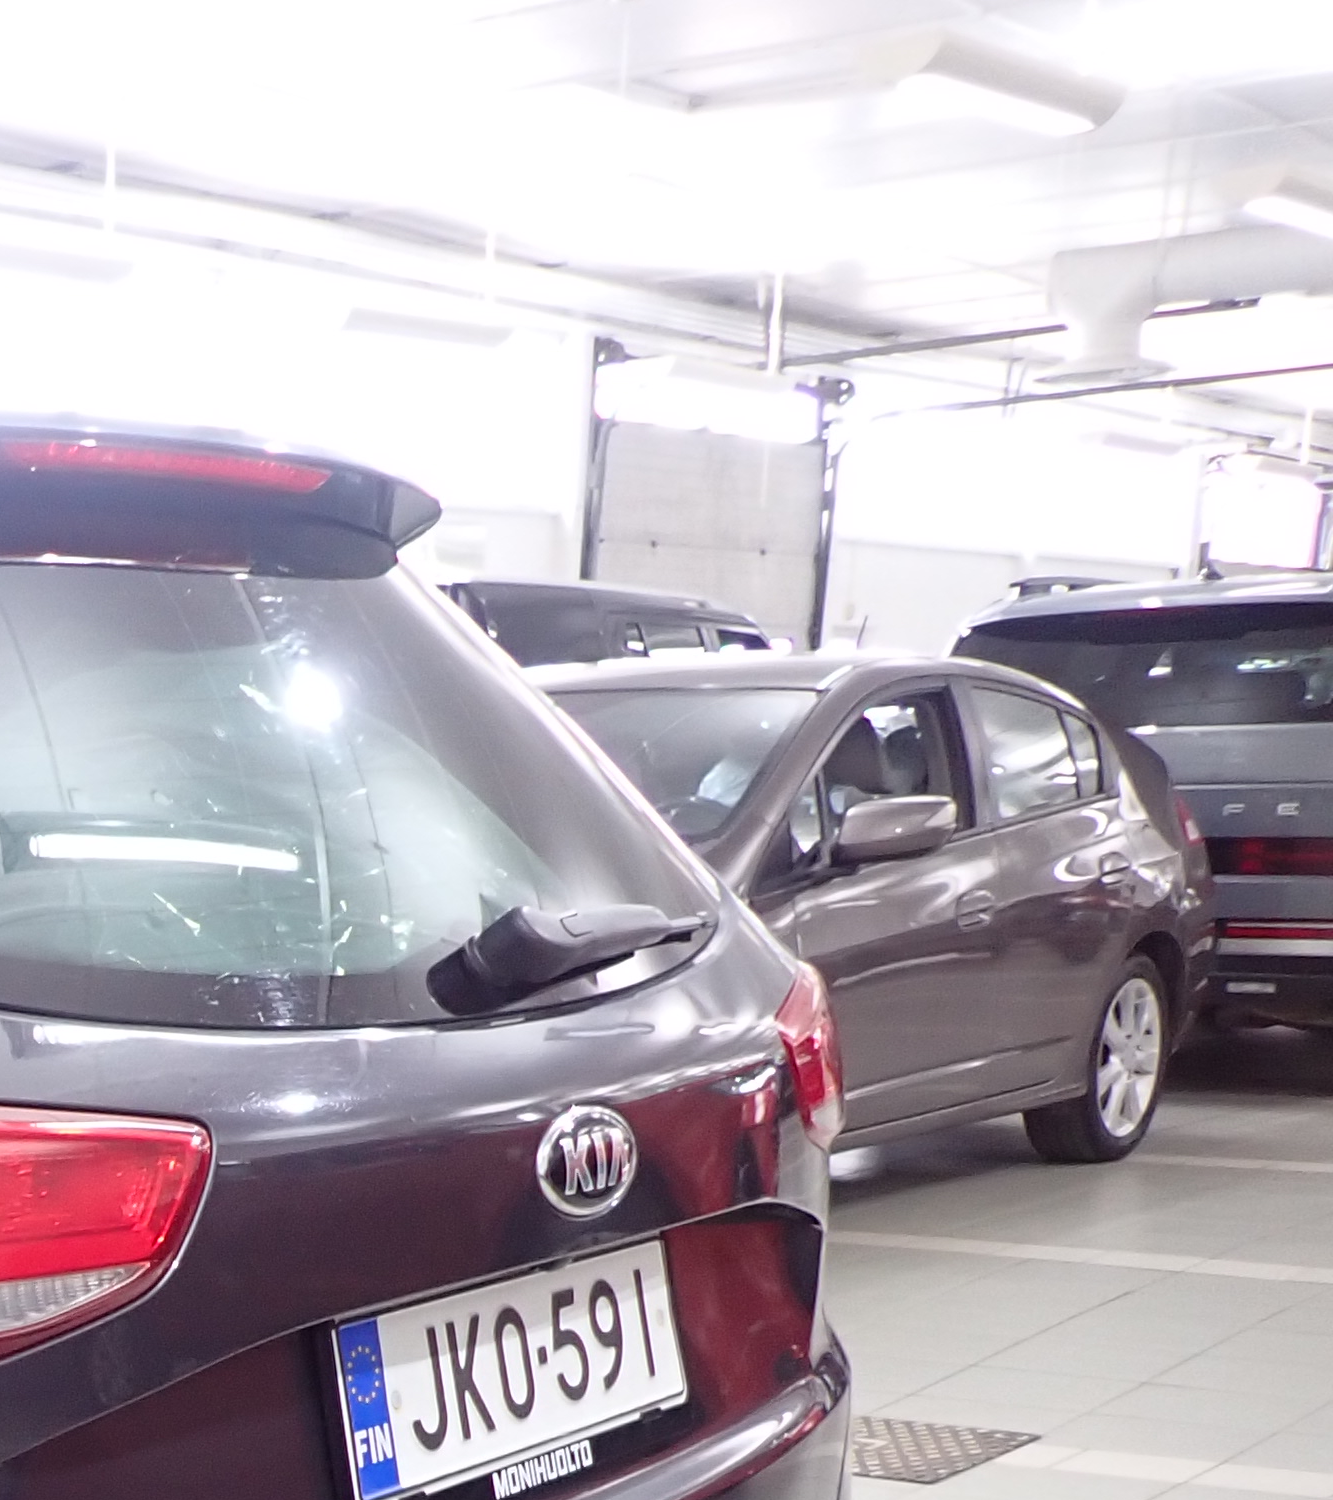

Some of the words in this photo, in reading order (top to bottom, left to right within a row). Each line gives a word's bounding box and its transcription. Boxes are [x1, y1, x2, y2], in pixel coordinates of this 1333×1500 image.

[559, 1127, 630, 1196] KIA
[412, 1269, 657, 1452] JKO-591
[353, 1423, 395, 1469] FIN
[491, 1439, 593, 1500] MONIHUOLTO
